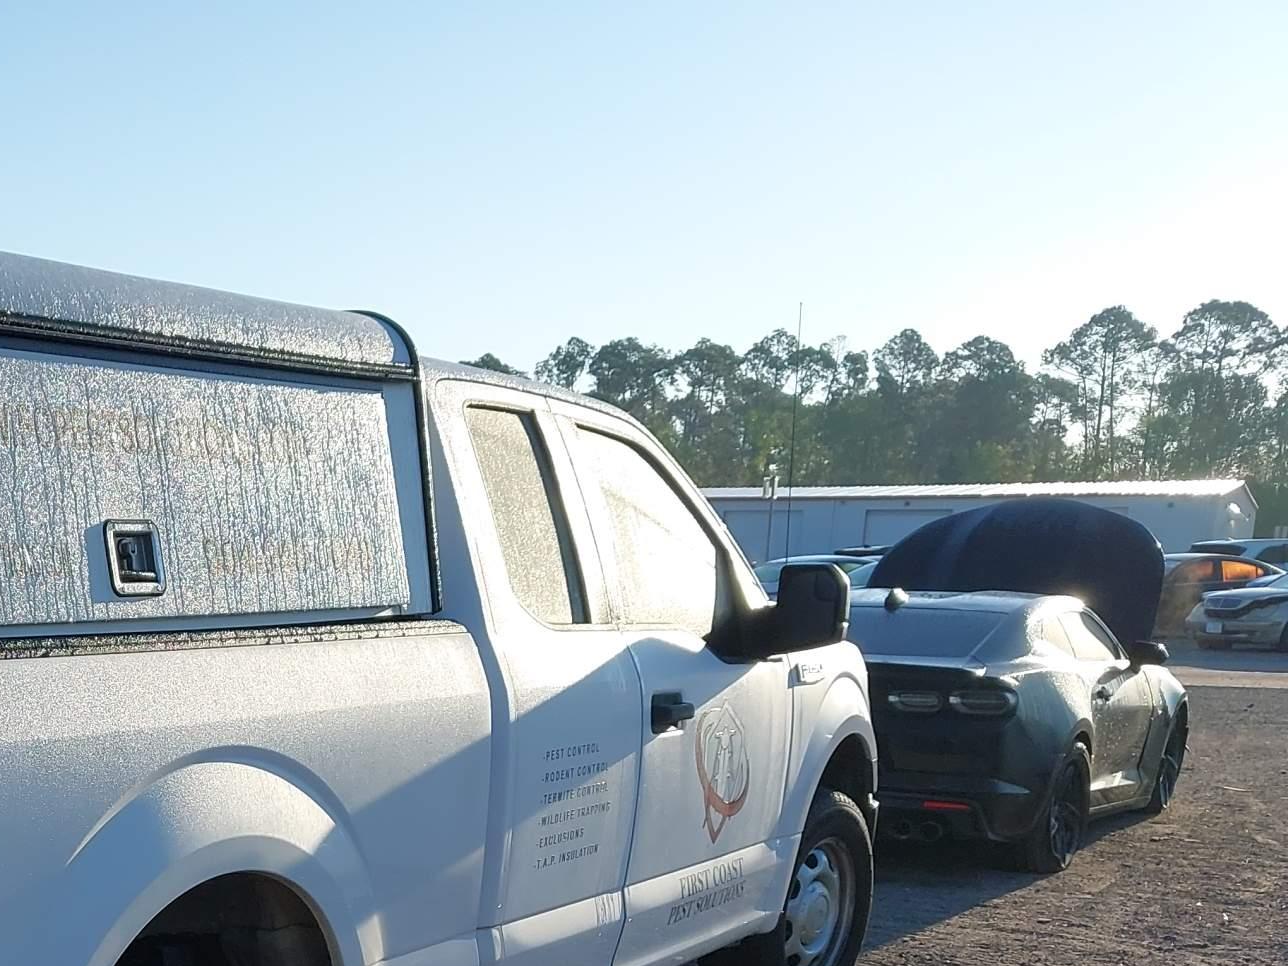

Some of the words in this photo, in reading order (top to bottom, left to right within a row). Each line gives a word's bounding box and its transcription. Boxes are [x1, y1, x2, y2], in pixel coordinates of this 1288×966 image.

[567, 743, 600, 757] CONTROL
[577, 762, 609, 777] CONTROL
[576, 782, 609, 798] CONTROL
[576, 800, 611, 817] TRAPPING
[558, 844, 599, 863] INSULATION
[679, 868, 712, 899] FIRST
[713, 857, 744, 887] COAST
[667, 901, 694, 925] PEST
[693, 880, 748, 913] SOLUTIONS
